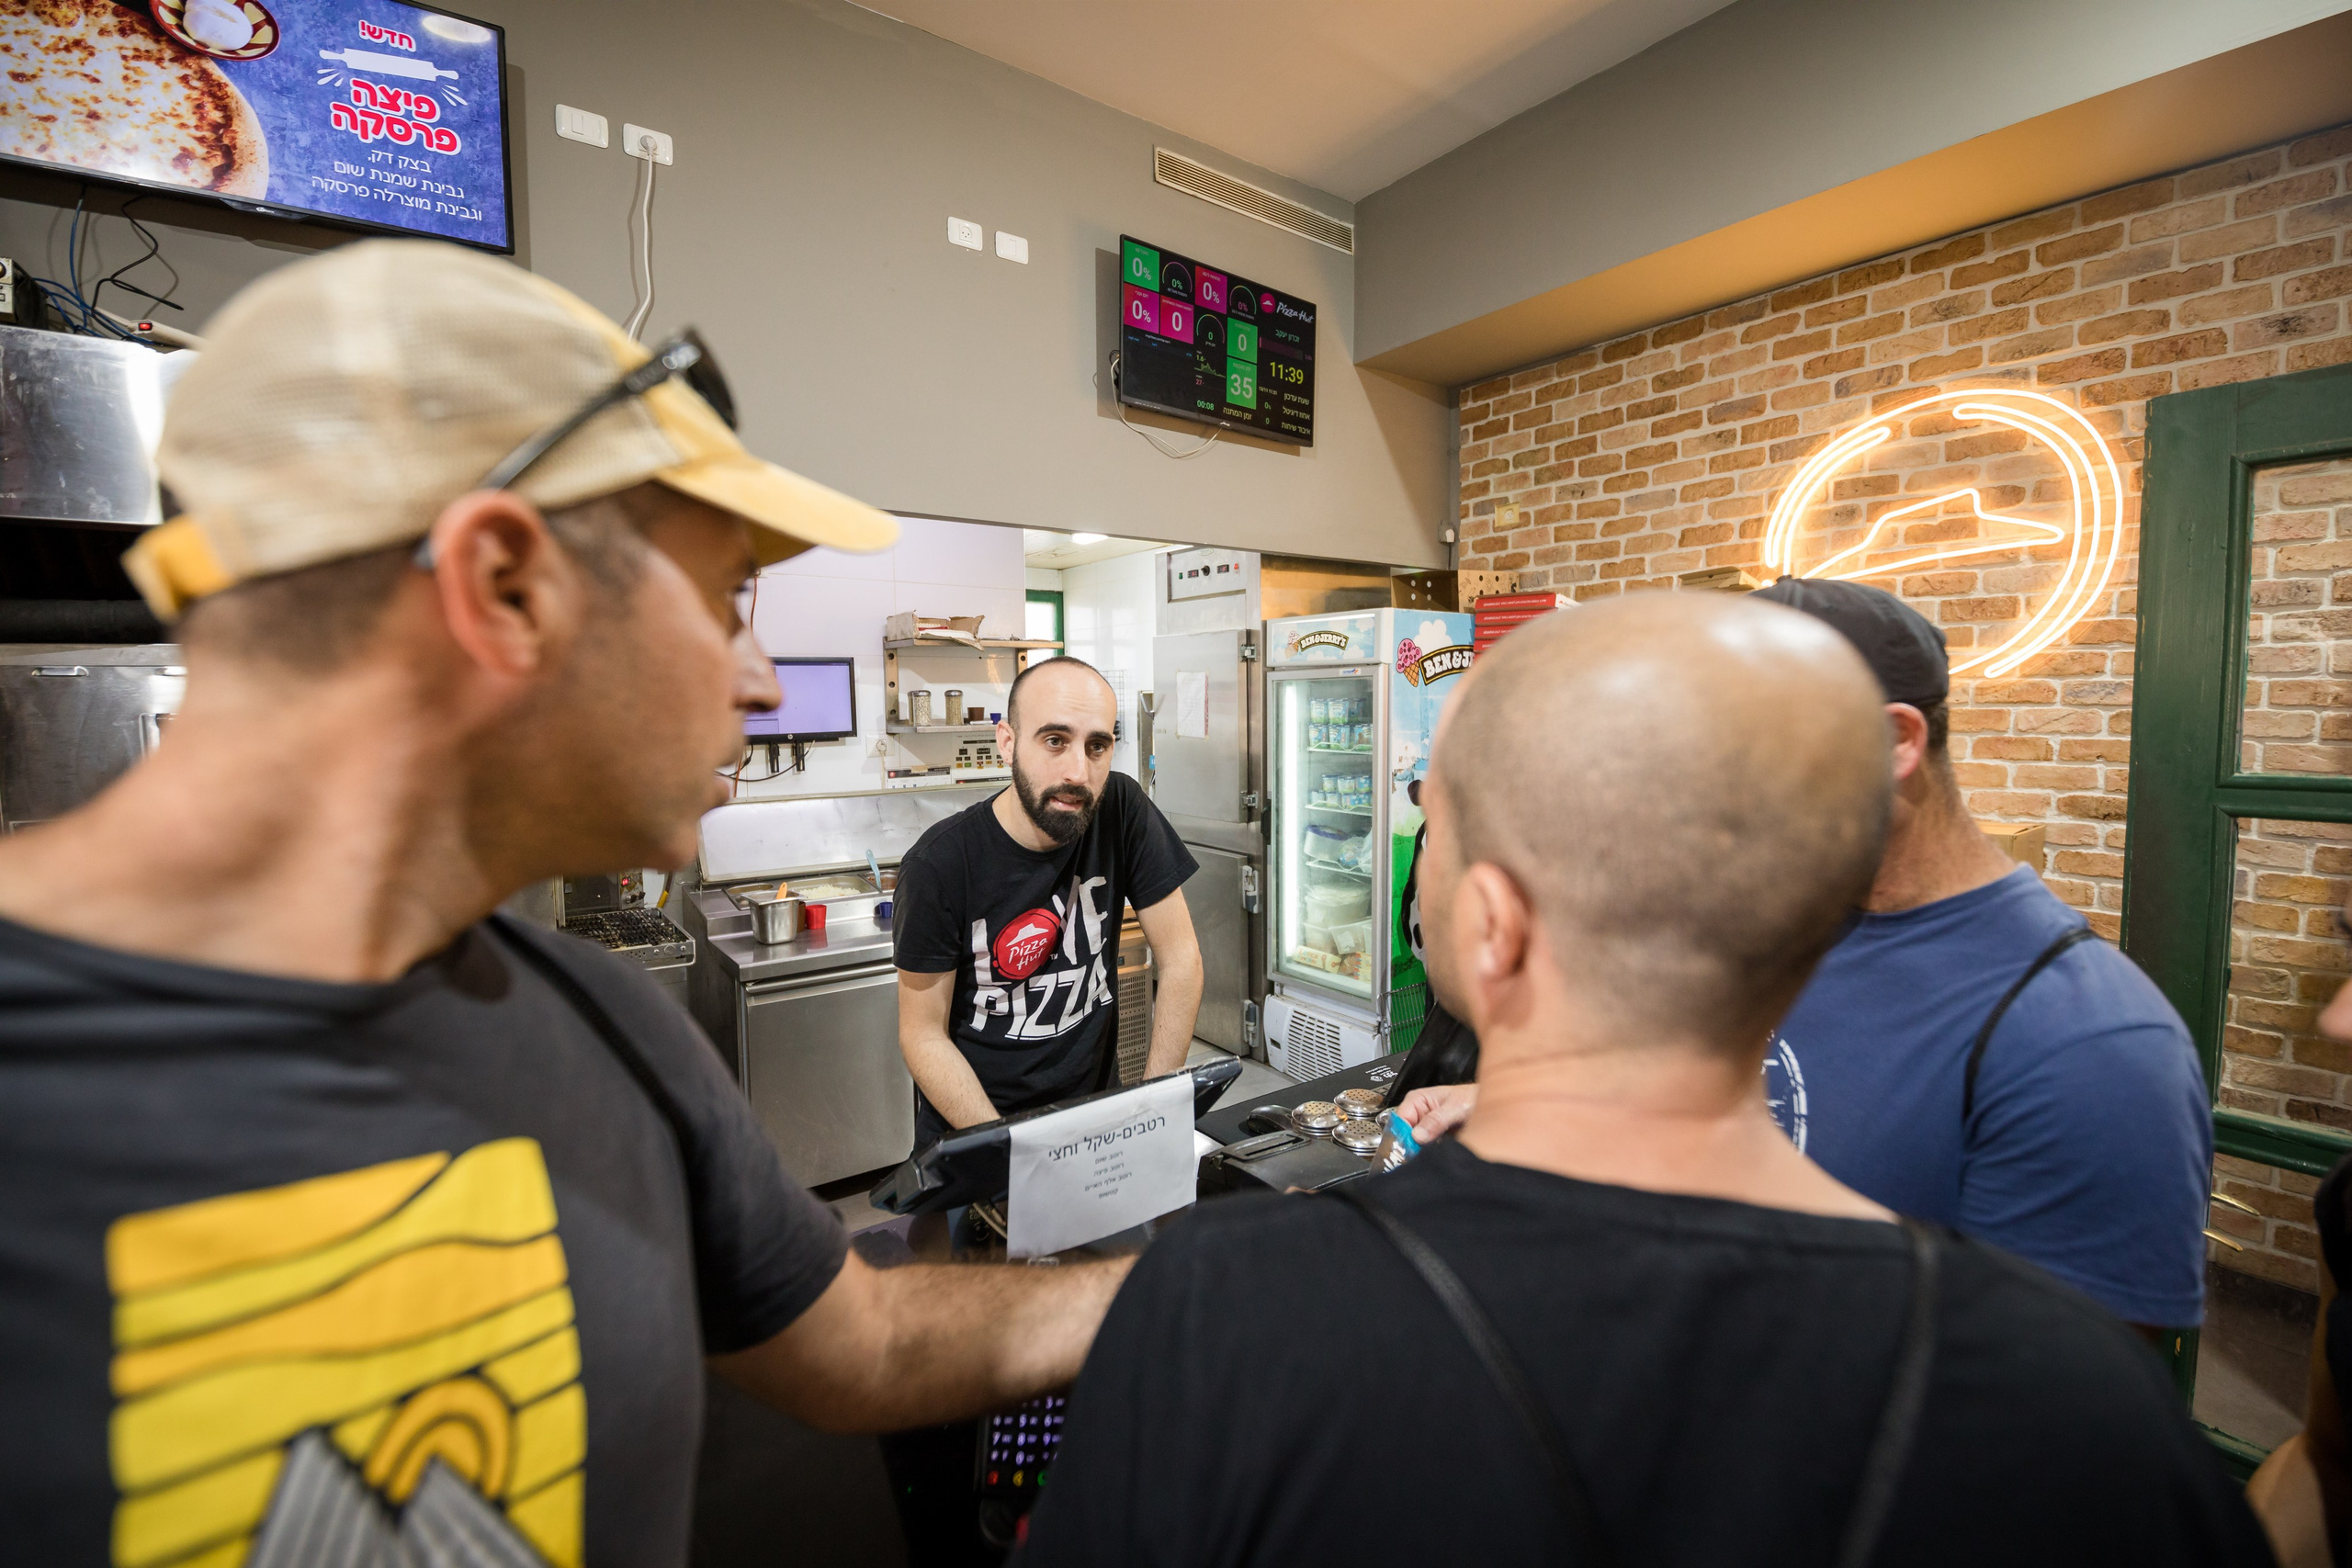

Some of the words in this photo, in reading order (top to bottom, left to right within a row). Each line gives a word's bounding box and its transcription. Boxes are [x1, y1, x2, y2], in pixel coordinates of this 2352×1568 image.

[359, 20, 415, 51] חדש!
[351, 79, 437, 120] פיצה
[332, 103, 458, 153] פרסקה
[334, 161, 365, 177] שום
[398, 155, 431, 173] בצק
[311, 176, 369, 197] פרסקה
[370, 170, 417, 187] שמנת
[421, 179, 465, 198] גבינת
[373, 189, 431, 210] מוצרלה
[435, 202, 482, 221] וגבינת
[1171, 311, 1182, 332] 0
[1276, 301, 1298, 318] Pizza
[1298, 310, 1315, 324] Hut
[1238, 333, 1248, 352] 0
[1270, 361, 1304, 385] 11:39
[1230, 373, 1253, 399] 35
[1009, 936, 1048, 964] Pizza
[1016, 946, 1046, 971] Hut
[969, 950, 1114, 1041] PIZZA
[1083, 1116, 1166, 1153] רטבים-שקל
[1048, 1142, 1079, 1162] וחצי
